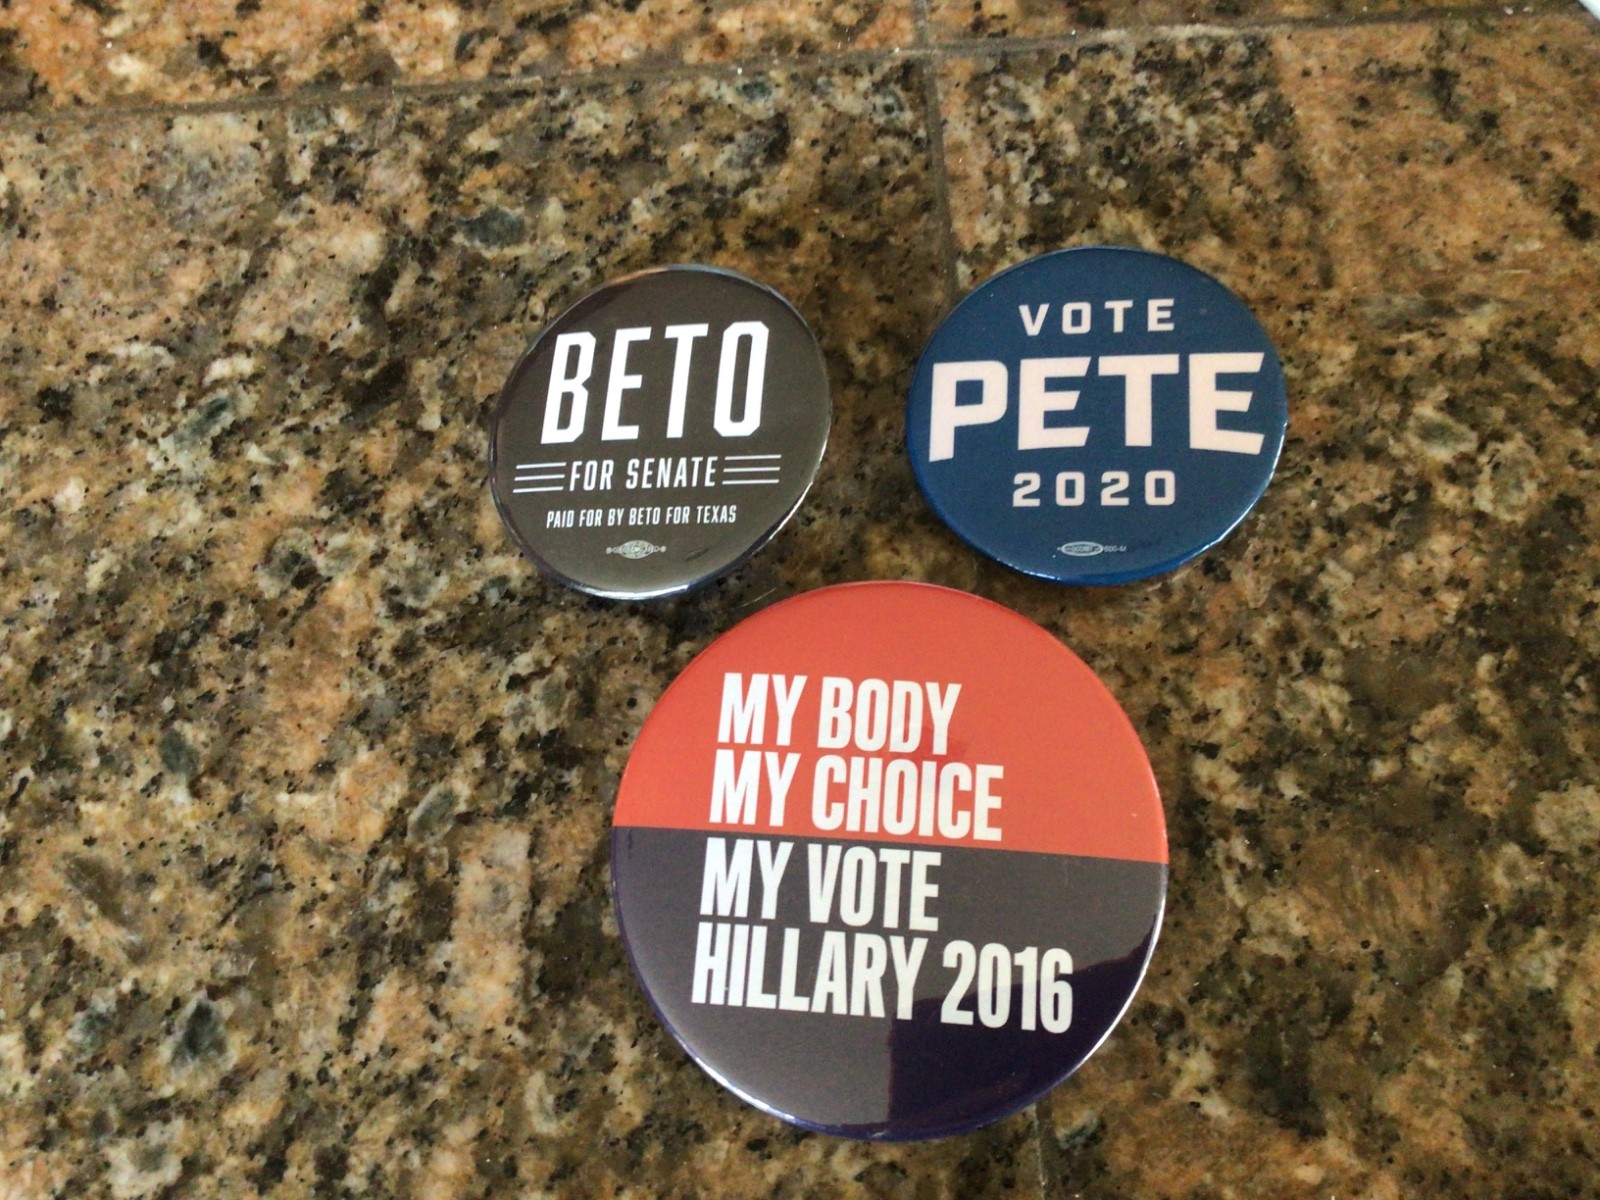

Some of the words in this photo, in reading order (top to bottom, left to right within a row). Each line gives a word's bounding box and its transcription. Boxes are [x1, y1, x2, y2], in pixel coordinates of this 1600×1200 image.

[1018, 298, 1175, 336] VOTE
[540, 321, 769, 444] BETO
[928, 352, 1265, 462] PETE
[546, 509, 574, 529] PAID
[579, 508, 602, 527] FOR
[607, 508, 624, 526] BY
[629, 506, 661, 526] BETO
[665, 506, 690, 525] FOR
[696, 504, 737, 524] TEXAS
[569, 459, 614, 491] FOR
[625, 456, 719, 489] SENATE
[1012, 470, 1176, 508] 2020
[717, 672, 807, 746] MY
[817, 675, 962, 756] BODY
[709, 748, 801, 827] MY
[811, 755, 1004, 841] CHOICE
[699, 836, 794, 920] MY
[807, 843, 942, 932] VOTE
[691, 921, 928, 1020] HILLARY
[940, 939, 1074, 1034] 2016
